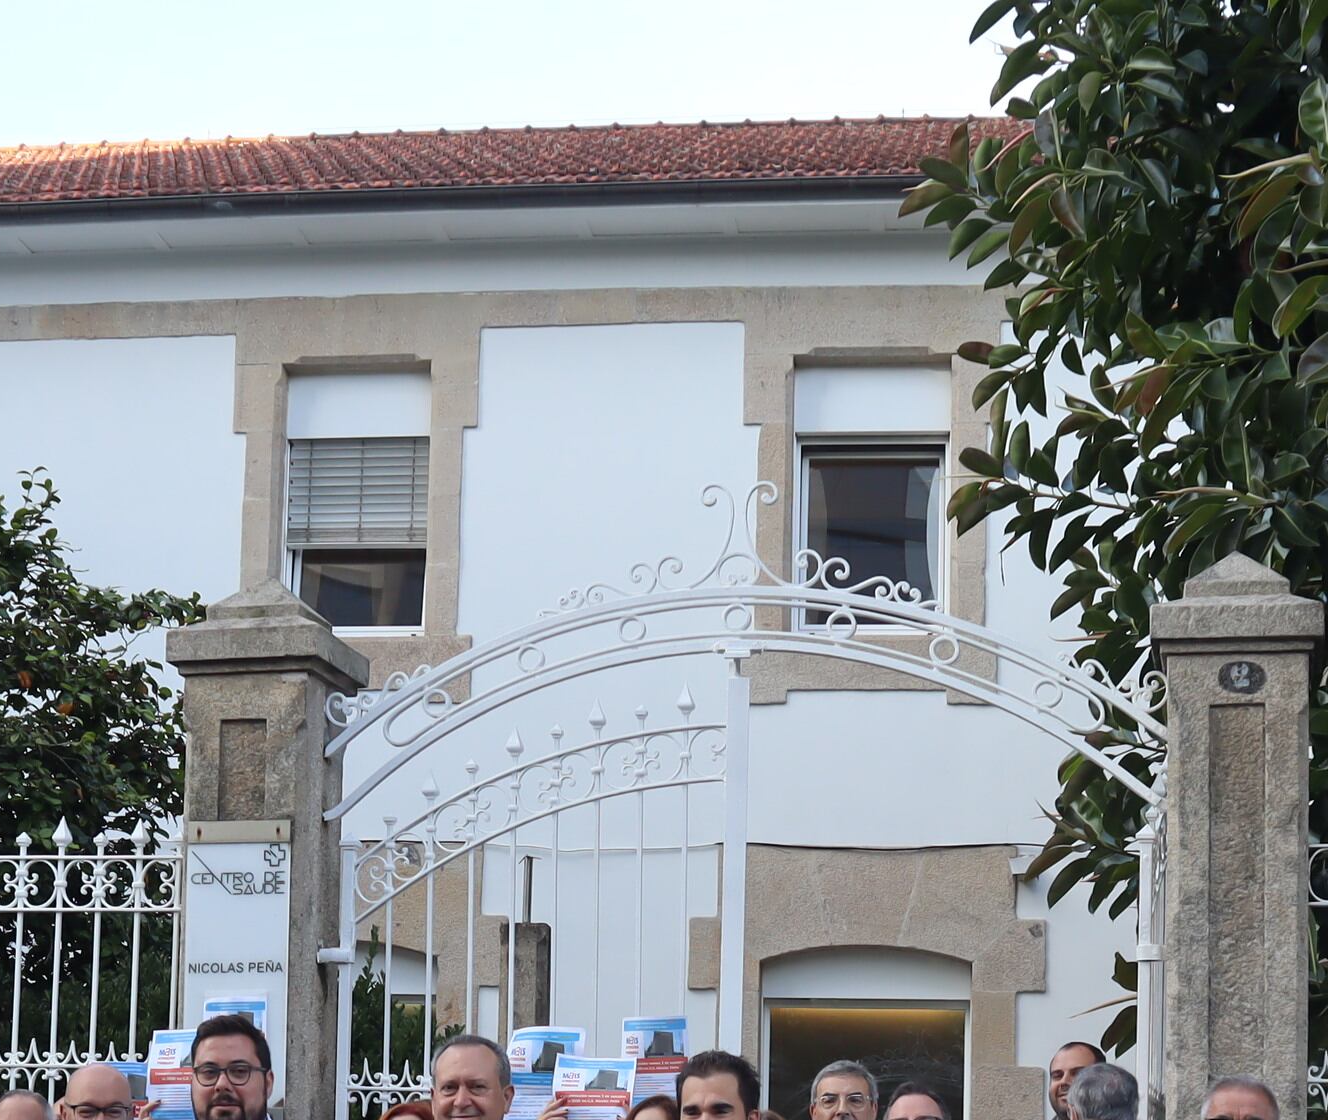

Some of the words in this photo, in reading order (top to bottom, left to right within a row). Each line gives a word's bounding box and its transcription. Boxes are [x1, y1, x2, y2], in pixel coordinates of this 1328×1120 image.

[190, 872, 254, 885] CENTRO
[264, 871, 286, 884] DE
[232, 882, 286, 895] SAUDE
[188, 962, 244, 974] NICOLAS
[248, 960, 283, 973] PEÑA
